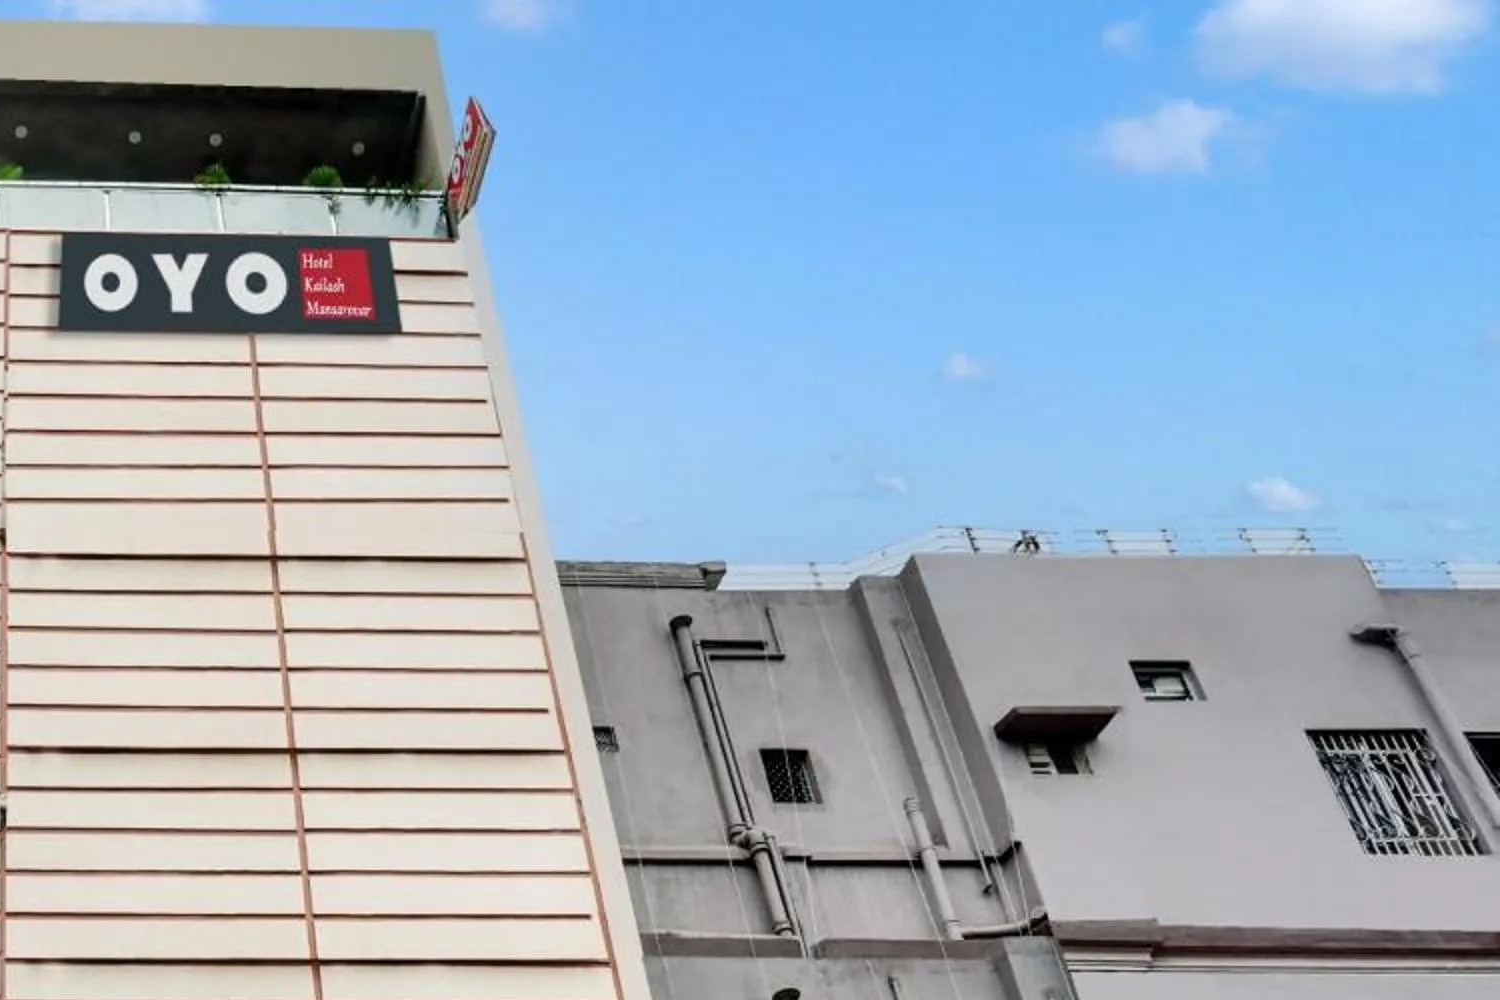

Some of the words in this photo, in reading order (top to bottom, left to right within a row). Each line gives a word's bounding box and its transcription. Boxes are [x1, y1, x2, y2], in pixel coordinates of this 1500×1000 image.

[302, 253, 333, 269] Hotel
[84, 252, 287, 315] OYO
[304, 276, 346, 293] Kailash
